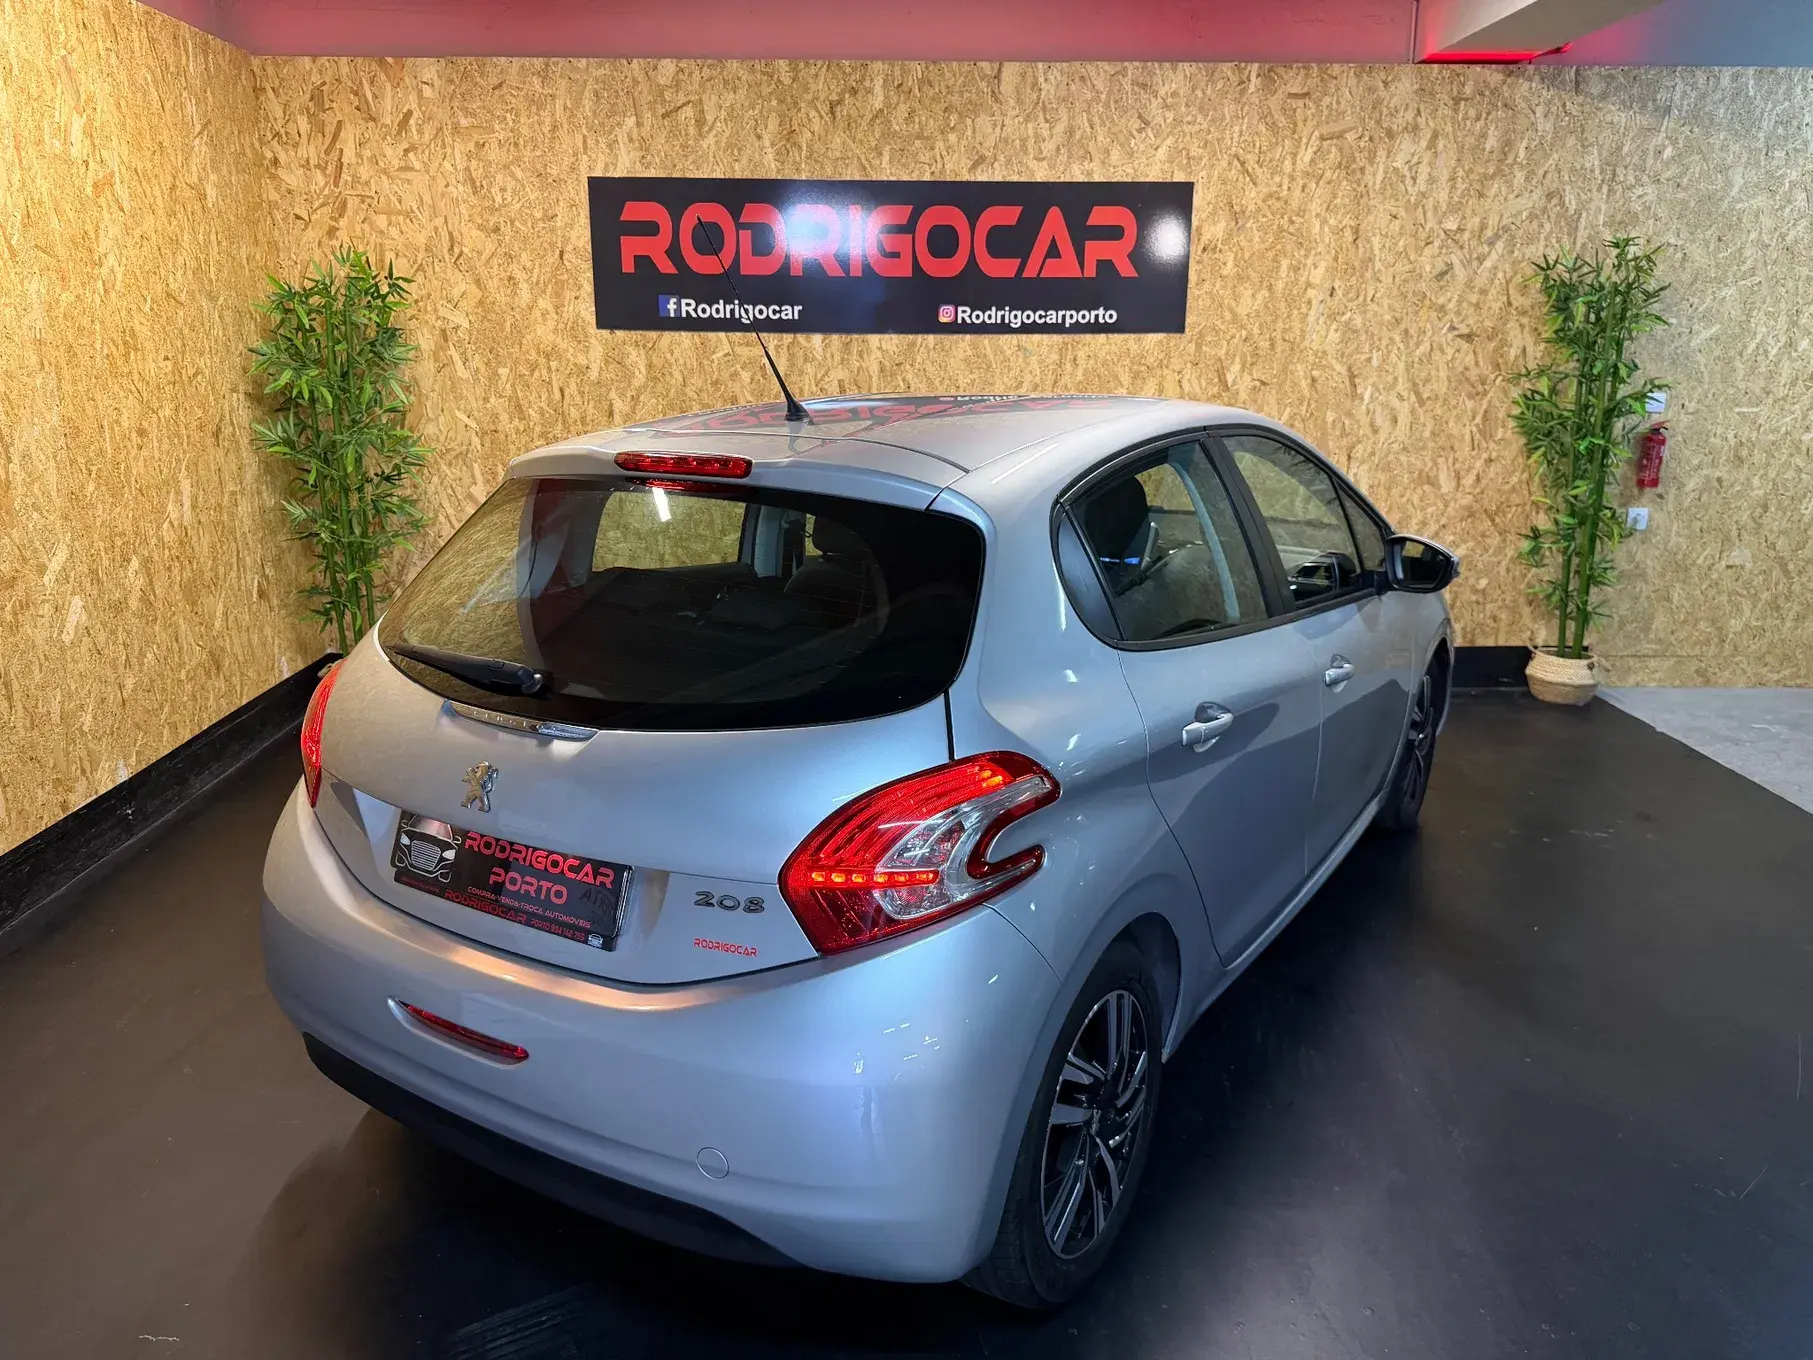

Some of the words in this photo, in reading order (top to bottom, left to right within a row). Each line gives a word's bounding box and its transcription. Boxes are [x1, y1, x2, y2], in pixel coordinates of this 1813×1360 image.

[619, 201, 1139, 278] RODRIGOCAR
[680, 298, 803, 324] Rodrigocar
[957, 305, 1118, 328] Rodrigocarporto
[464, 831, 616, 889] RODRIGOCAR
[488, 867, 568, 905] PORTO
[444, 889, 527, 924] RODRIGOCAR
[693, 890, 765, 914] 208
[693, 938, 758, 957] RODRIGOCAR
